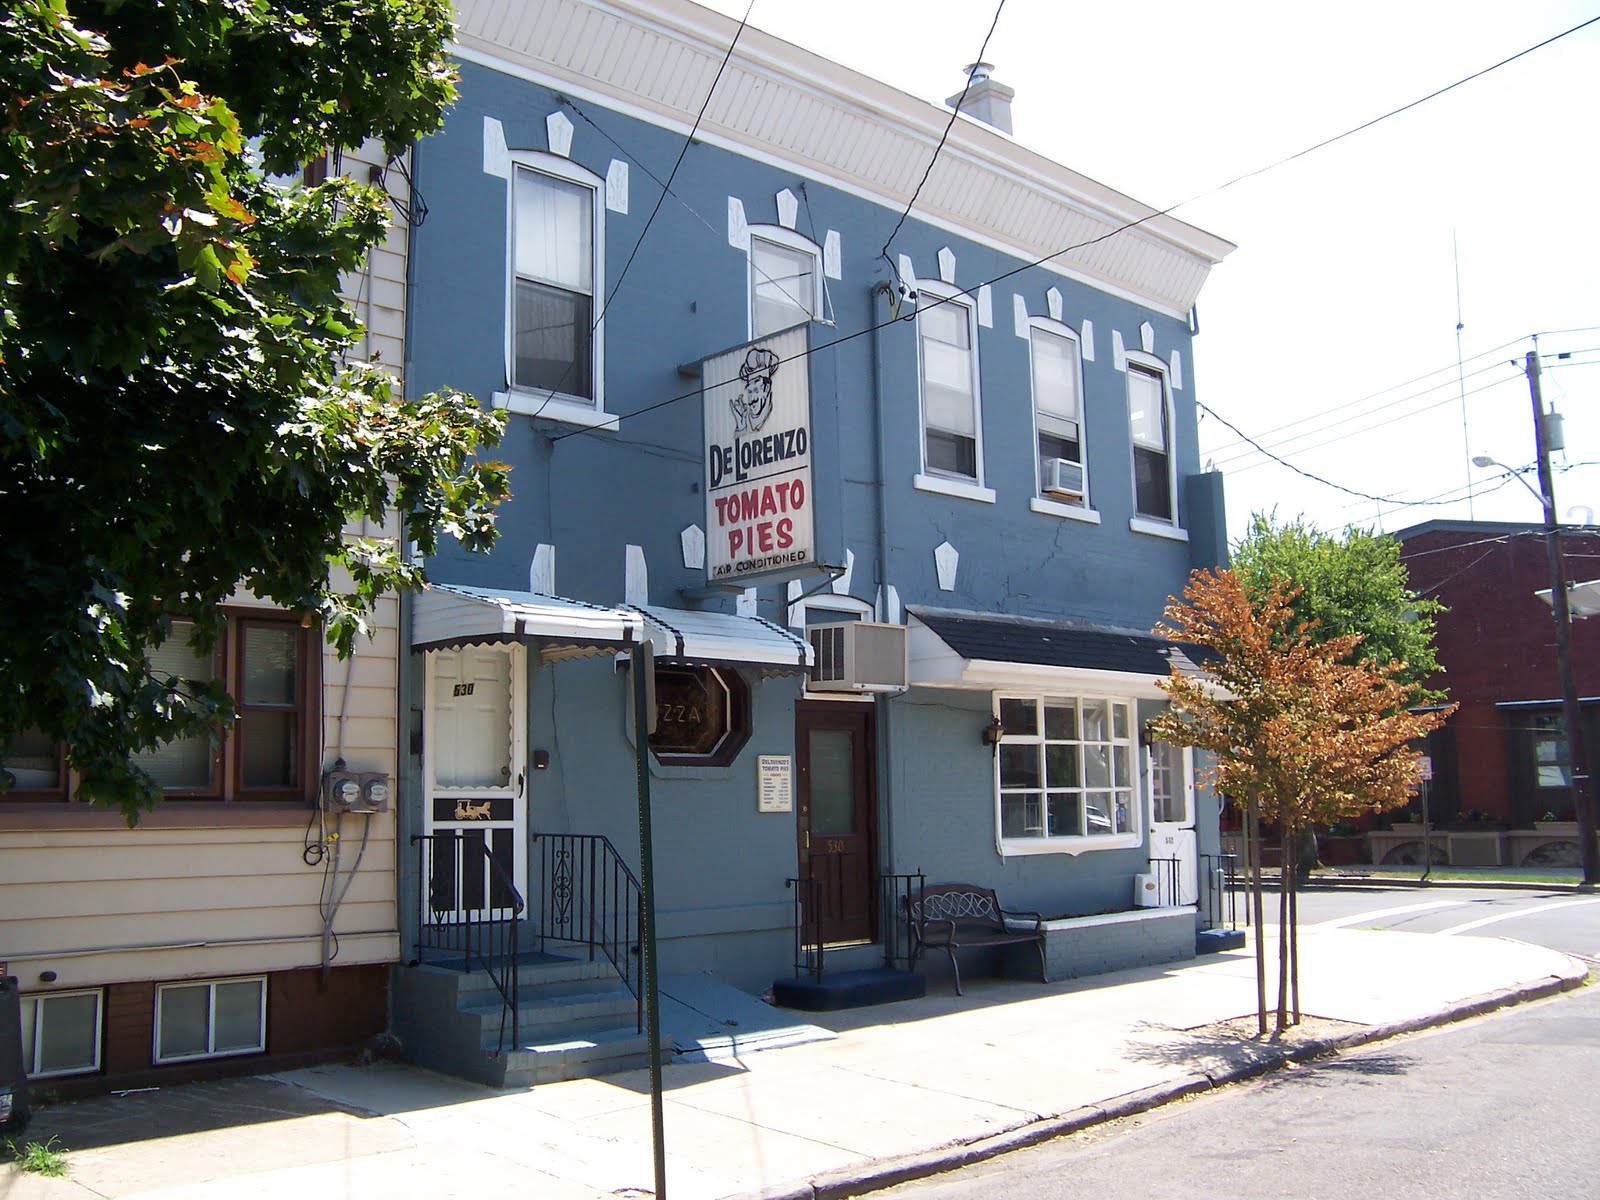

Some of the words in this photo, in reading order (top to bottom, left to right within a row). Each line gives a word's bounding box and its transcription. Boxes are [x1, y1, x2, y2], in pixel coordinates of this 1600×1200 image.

[715, 479, 804, 526] TOMATO
[728, 518, 793, 559] PIES
[716, 563, 732, 575] AIR
[736, 550, 806, 572] CONDITIONED
[661, 704, 701, 723] ZZA
